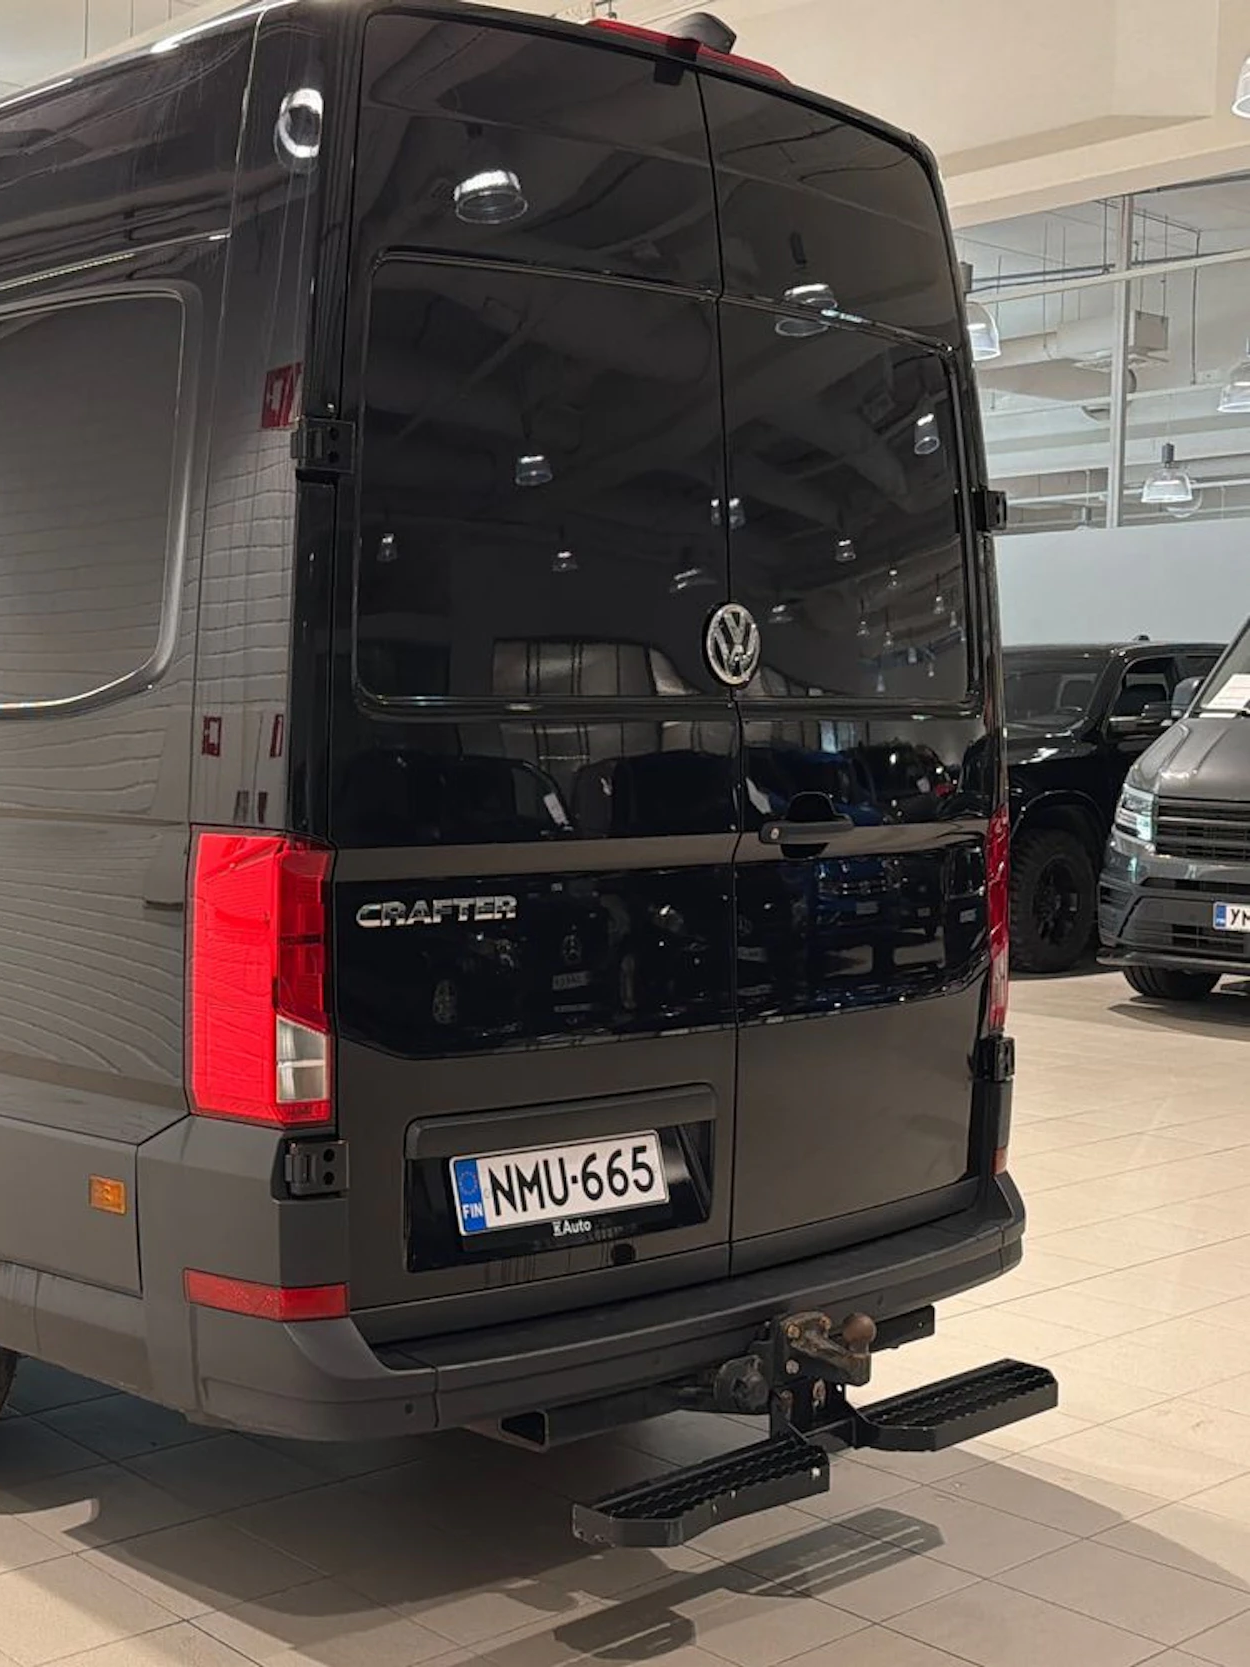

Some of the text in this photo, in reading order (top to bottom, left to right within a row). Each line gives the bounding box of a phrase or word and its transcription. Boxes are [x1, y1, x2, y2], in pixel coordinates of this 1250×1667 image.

[355, 895, 518, 928] CRAFTER
[488, 1145, 654, 1216] NMU-665
[461, 1202, 484, 1221] FIN
